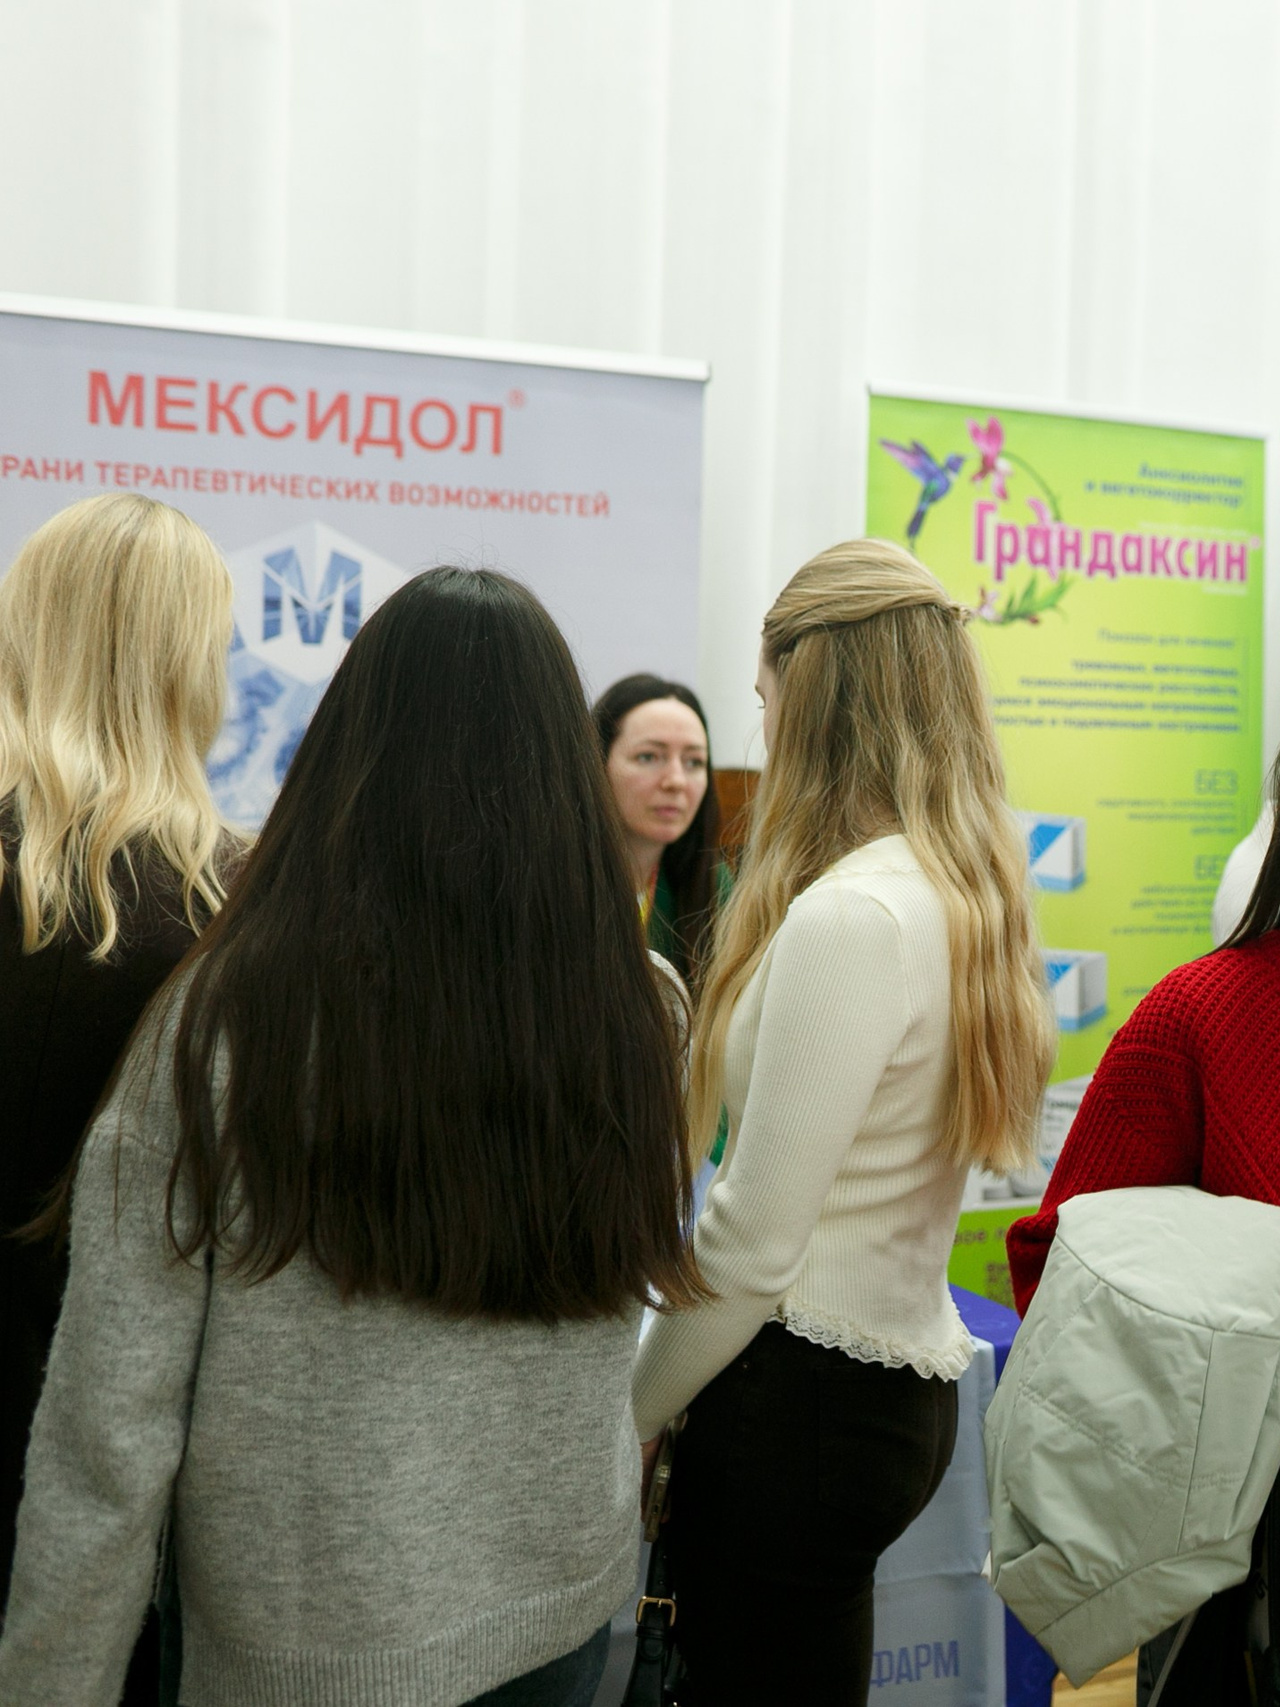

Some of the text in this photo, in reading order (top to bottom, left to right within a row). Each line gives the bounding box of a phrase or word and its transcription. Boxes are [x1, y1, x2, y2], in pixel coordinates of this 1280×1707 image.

[0, 454, 610, 517] РАНИ ТЕРАПЕВТИЧЕСКИХ ВОЗМОЖНОСТЕЙ
[974, 501, 1247, 582] Грандаксин
